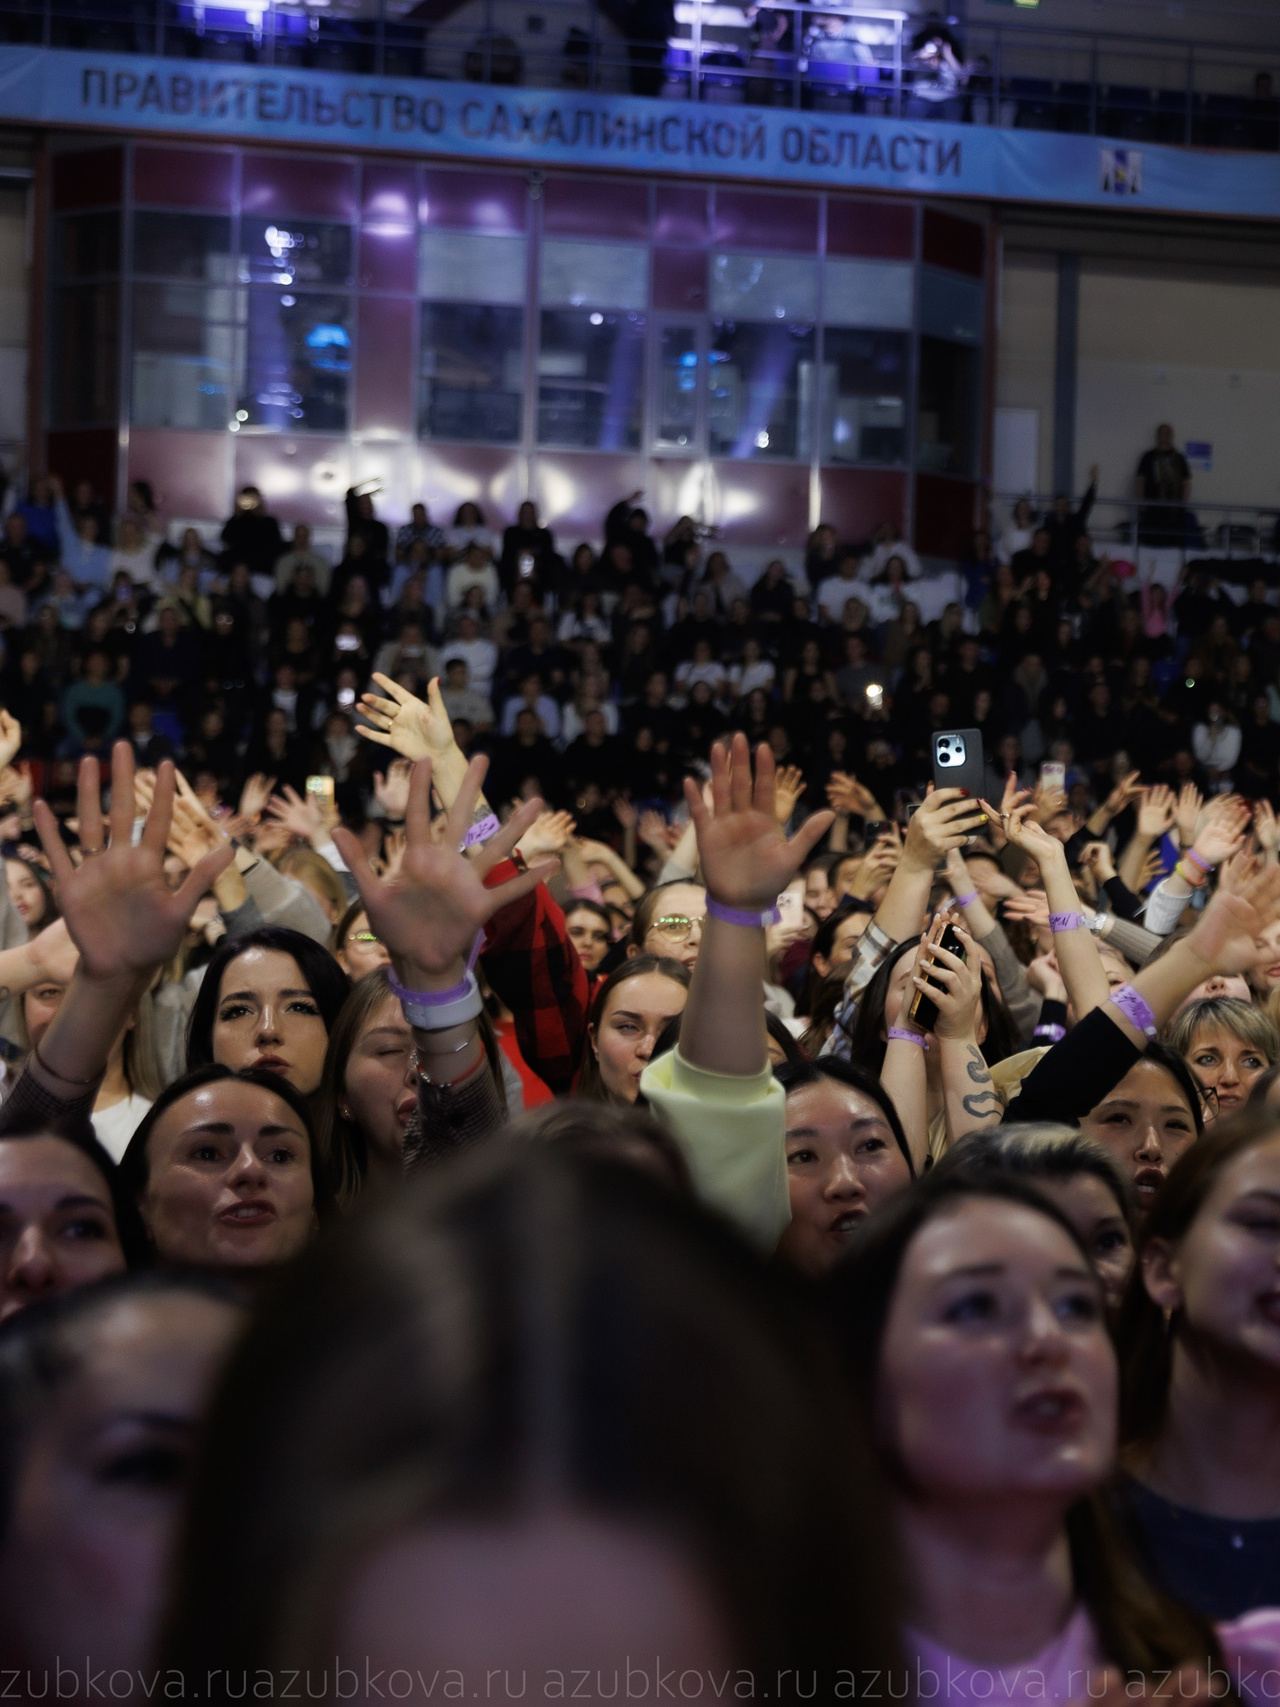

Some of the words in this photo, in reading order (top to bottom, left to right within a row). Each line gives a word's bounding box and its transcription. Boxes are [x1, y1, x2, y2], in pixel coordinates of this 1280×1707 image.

[81, 68, 444, 134] ПРАВИТЕЛЬСТВО
[459, 99, 767, 161] САХАЛИНСКОЙ
[780, 126, 963, 176] ОБЛАСТИ
